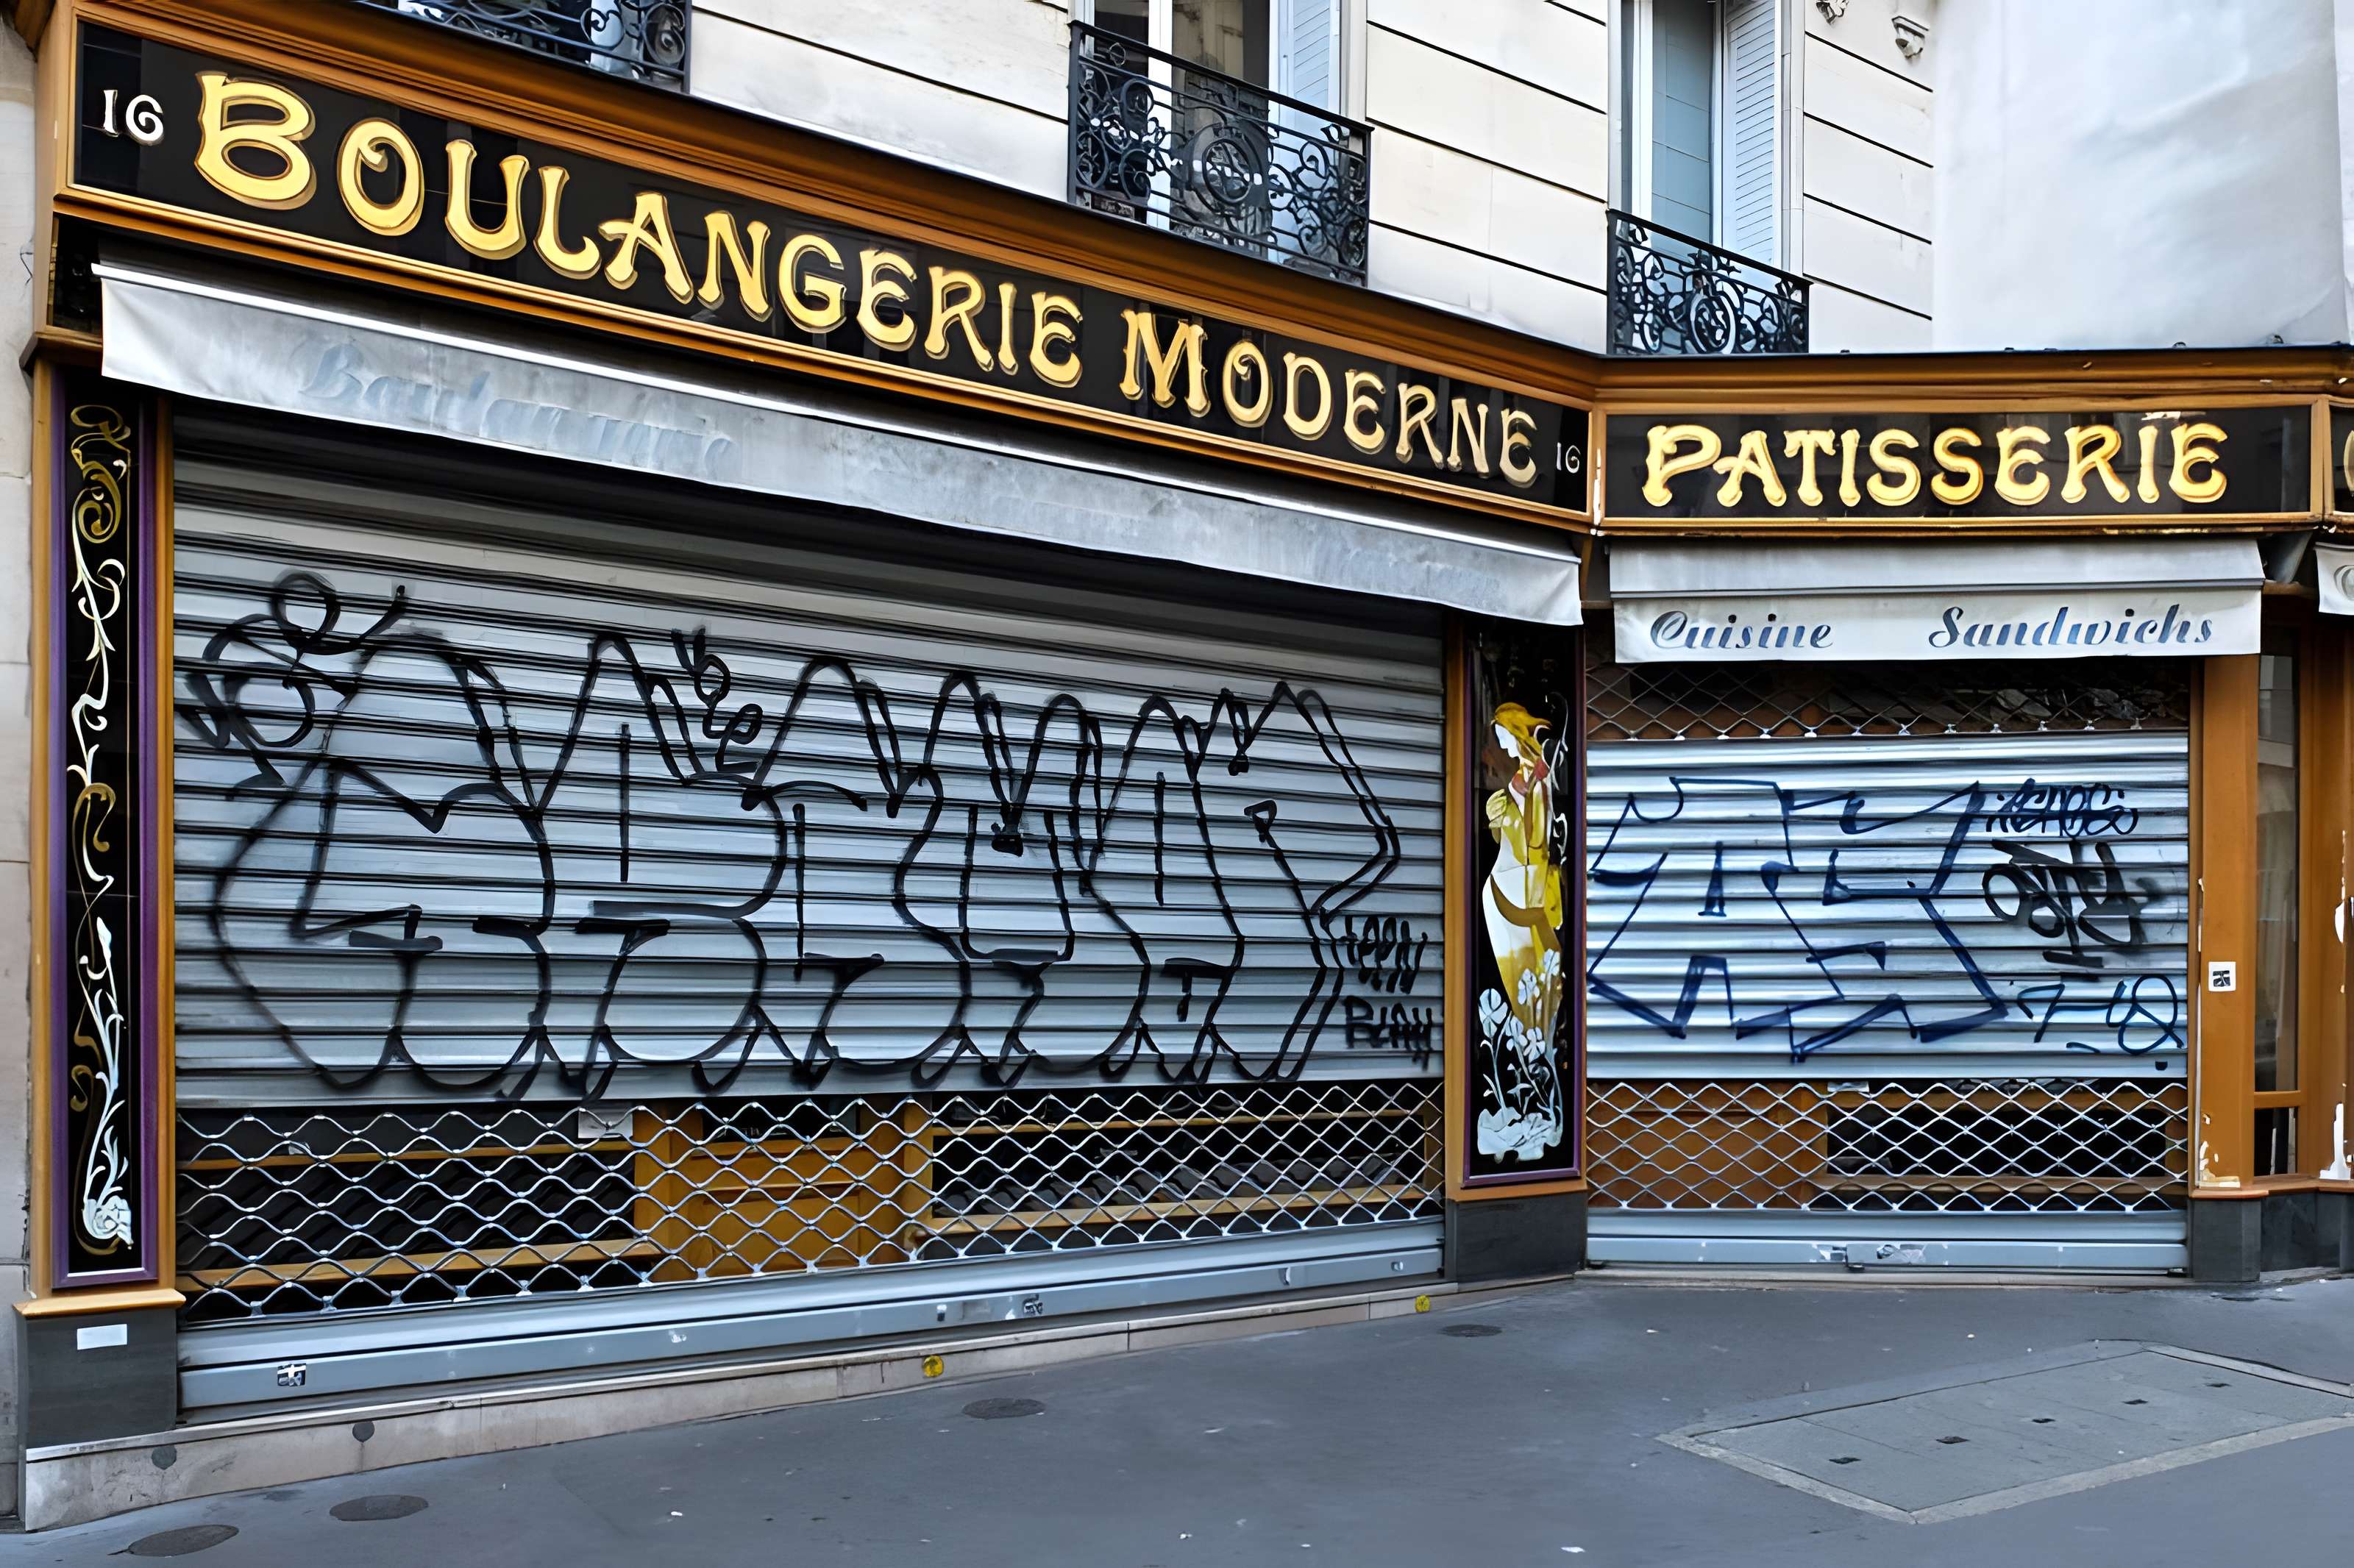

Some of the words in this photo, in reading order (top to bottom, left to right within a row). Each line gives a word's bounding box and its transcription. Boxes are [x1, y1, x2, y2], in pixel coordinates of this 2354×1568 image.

[103, 89, 164, 145] 16
[195, 71, 1083, 388] BOULANGERIE
[1120, 307, 1538, 488] MODERNE
[1556, 441, 1582, 474] 16
[1641, 422, 2228, 507] PATISSERIE
[1650, 609, 1835, 651] Cuisine
[1928, 603, 2213, 650] Sandwichs
